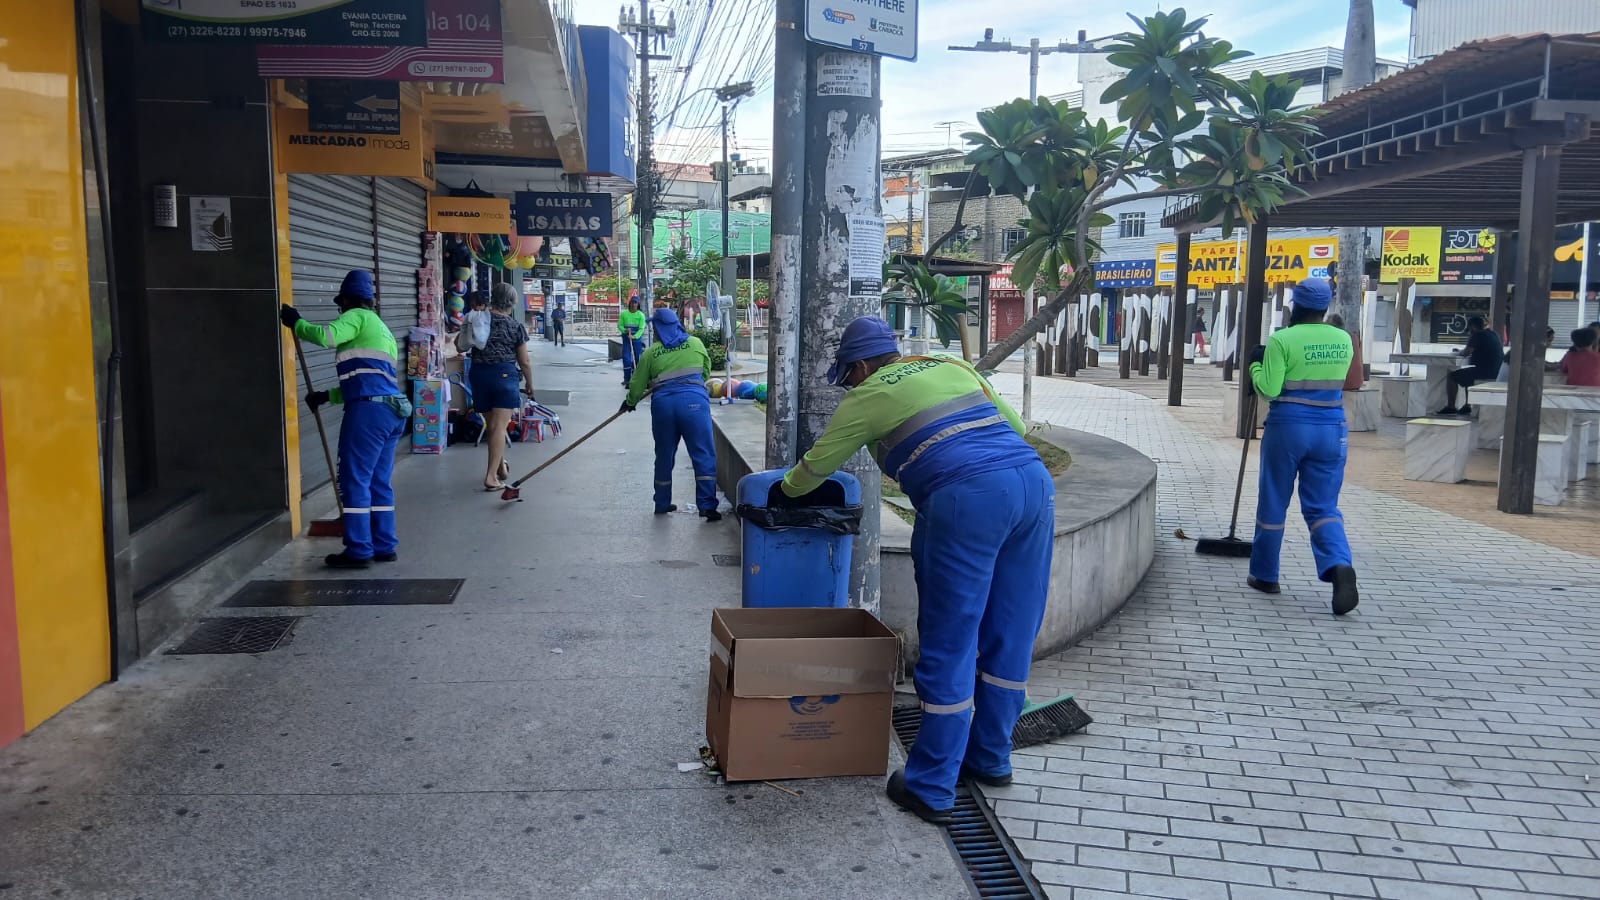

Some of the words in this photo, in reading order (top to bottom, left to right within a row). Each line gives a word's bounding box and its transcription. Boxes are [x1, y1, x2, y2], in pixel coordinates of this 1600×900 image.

[342, 12, 370, 20] EVANIA
[371, 12, 407, 21] OLIVEIRA
[456, 13, 491, 31] 104
[168, 26, 187, 38] (27)
[190, 26, 241, 37] 3226-8228
[249, 27, 307, 38] 99975-7946
[372, 137, 410, 150] moda
[536, 197, 593, 208] GALERIA
[527, 211, 601, 231] ISAÍAS
[1383, 253, 1430, 267] Kodak
